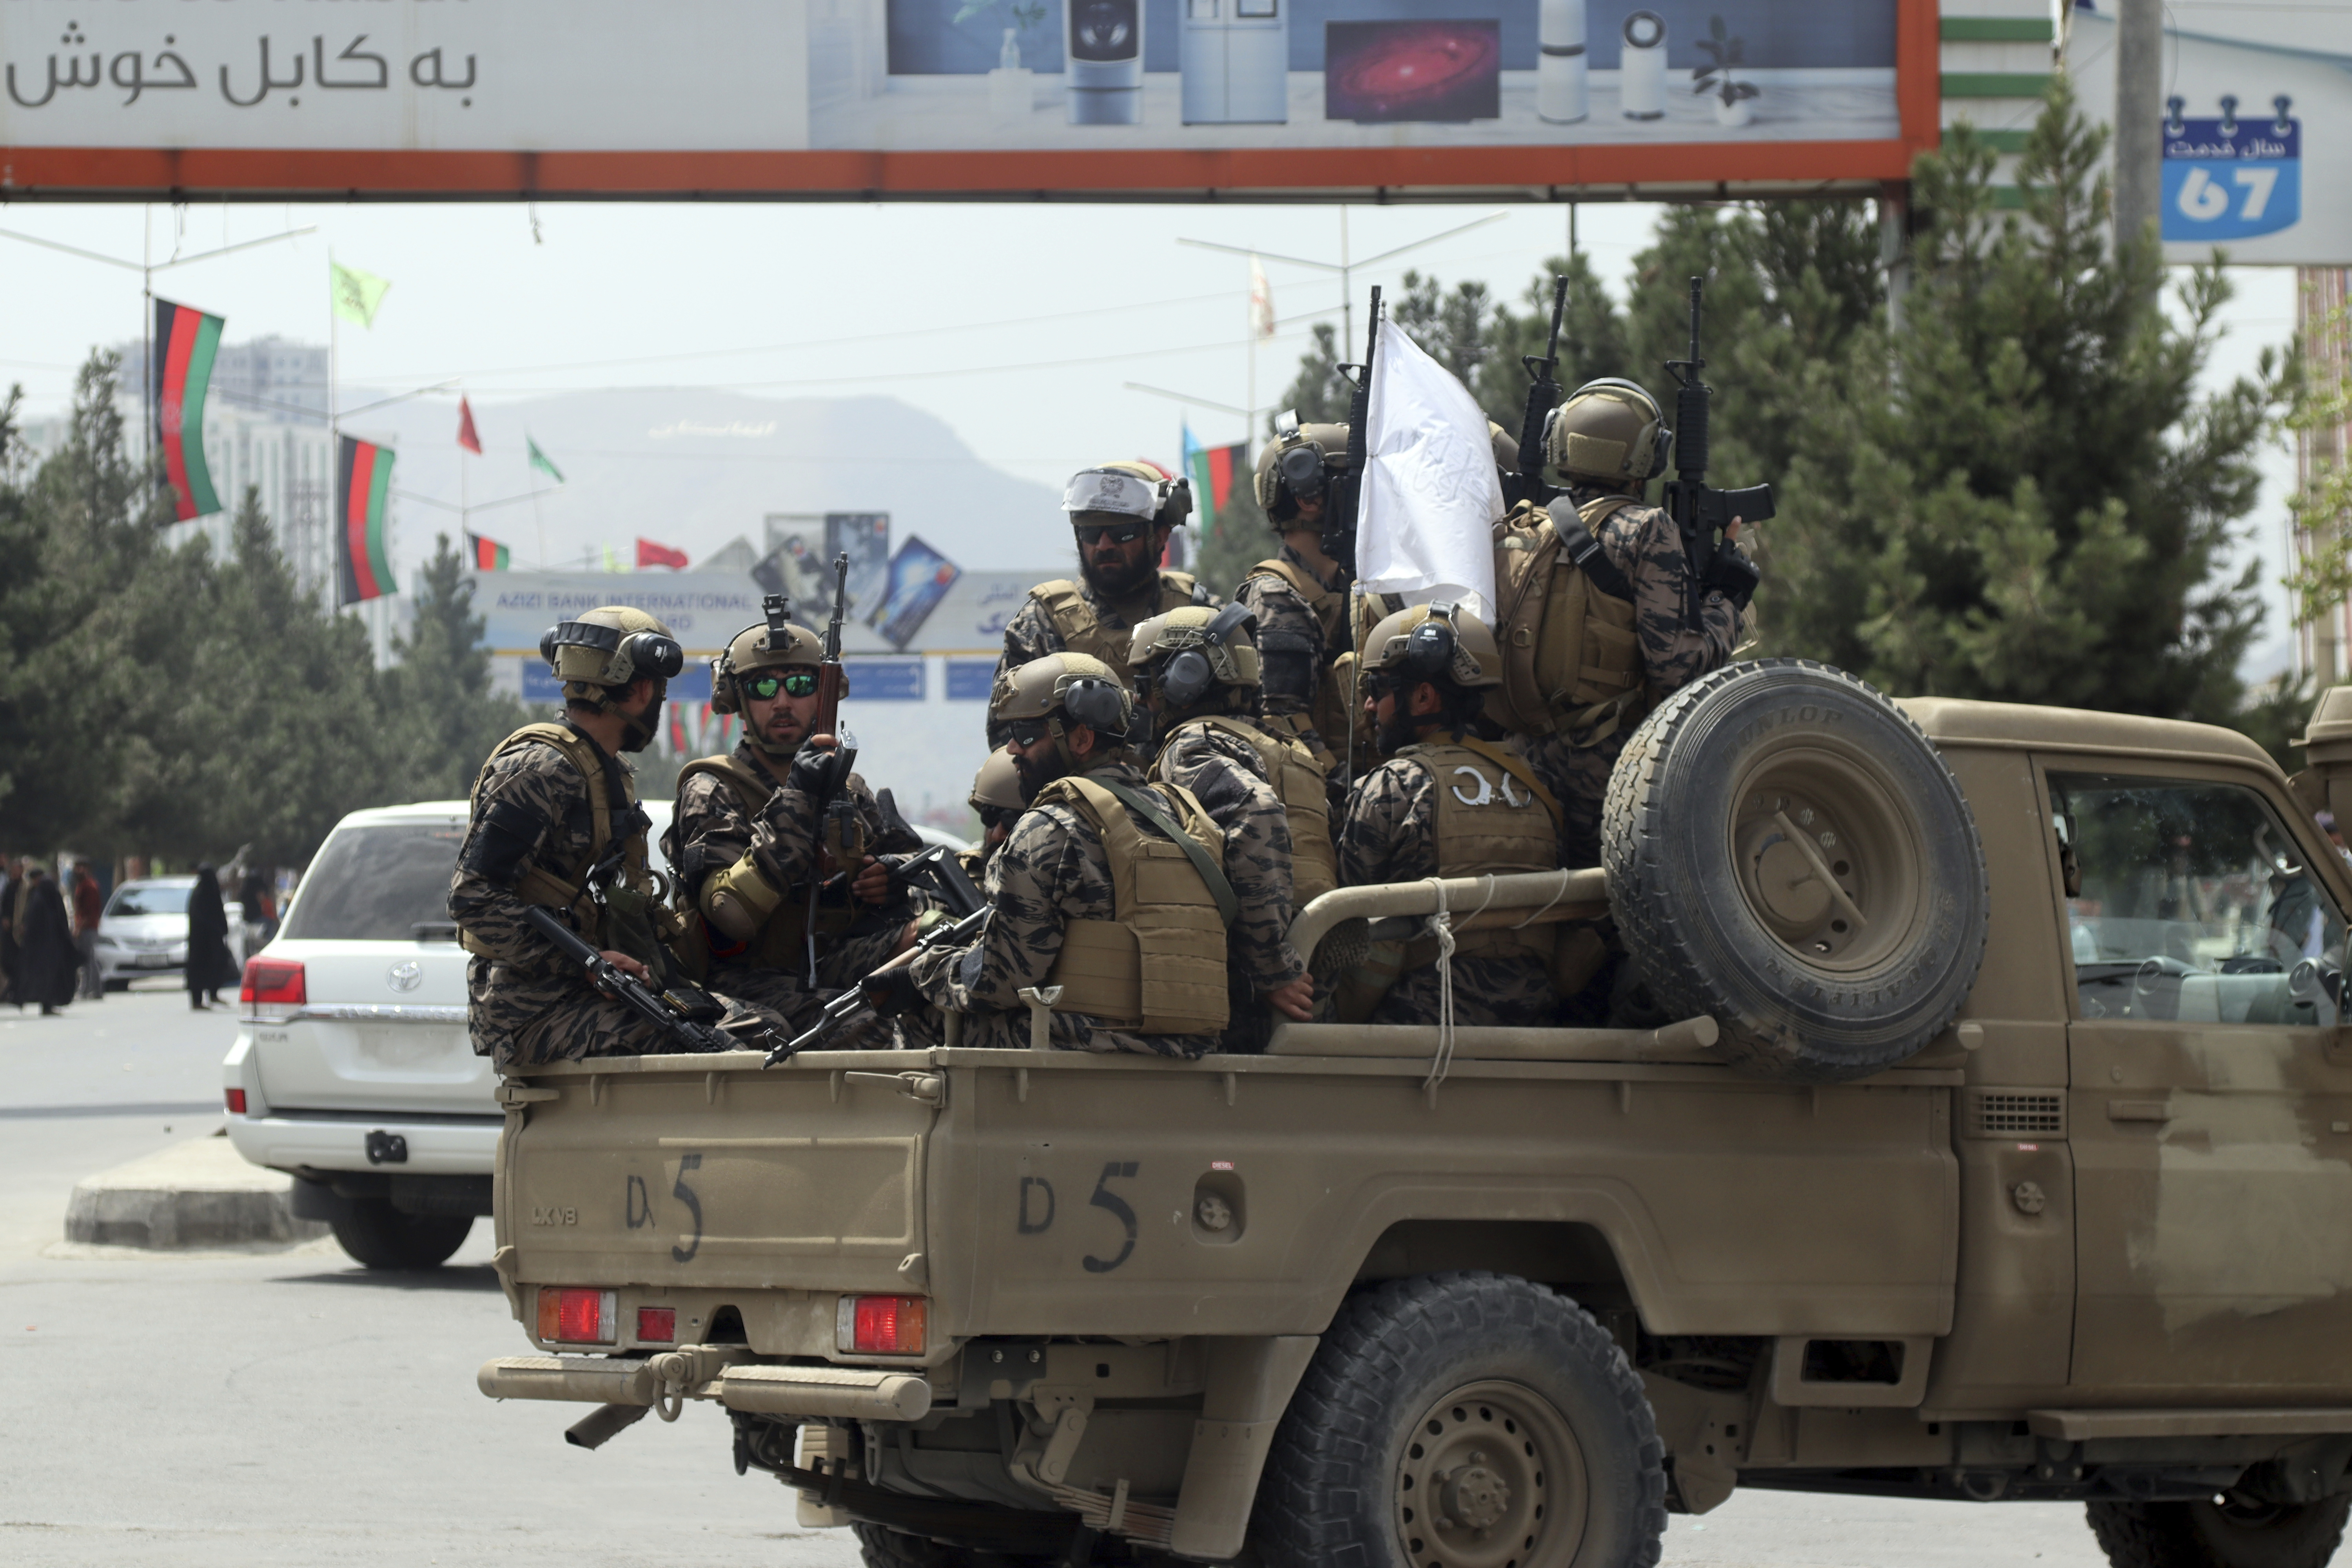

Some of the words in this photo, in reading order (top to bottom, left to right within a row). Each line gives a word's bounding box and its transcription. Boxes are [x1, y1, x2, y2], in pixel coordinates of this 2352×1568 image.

[4, 20, 198, 108] خوش
[218, 33, 388, 107] کابل
[409, 45, 477, 108] به
[2167, 138, 2236, 158] خدمت
[2239, 138, 2287, 162] سال
[2179, 167, 2279, 221] 67
[496, 593, 541, 607] AZIZI
[549, 593, 597, 608] BANK
[605, 593, 752, 611] INTERNATIONAL
[1721, 704, 1843, 768] DUNLOP
[532, 1207, 554, 1226] LX
[556, 1207, 577, 1226] V8
[626, 1175, 650, 1229] D
[671, 1154, 702, 1263] 5
[1017, 1177, 1055, 1234] D
[1082, 1162, 1140, 1273] 5
